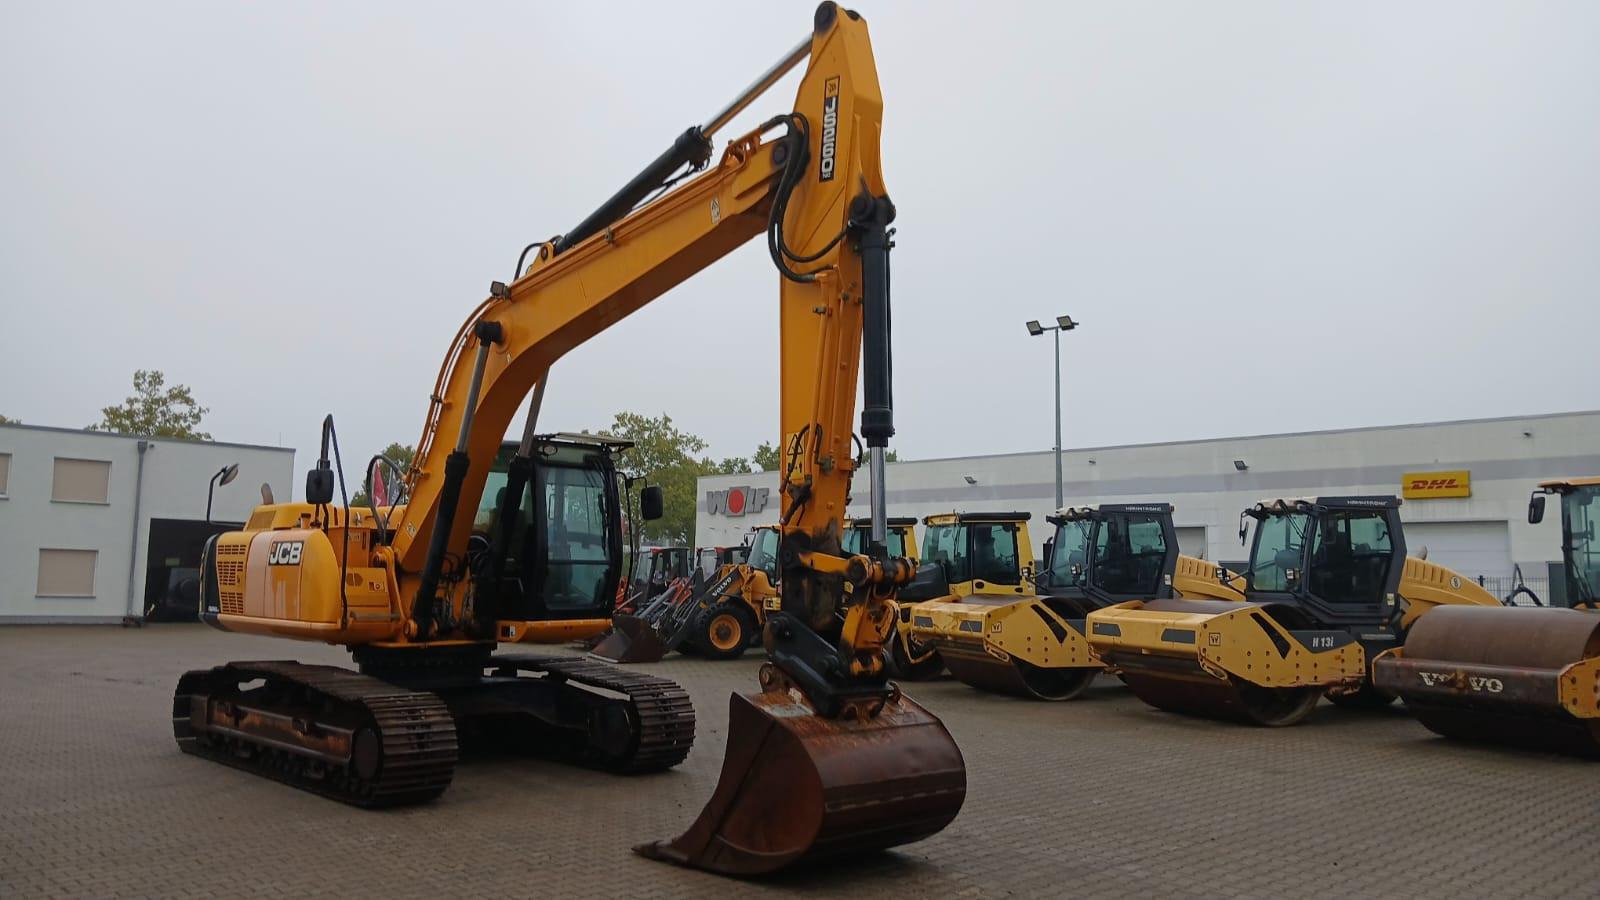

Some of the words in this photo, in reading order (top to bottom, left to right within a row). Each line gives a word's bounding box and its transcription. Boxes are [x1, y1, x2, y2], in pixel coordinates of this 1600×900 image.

[822, 97, 836, 171] JS260
[1411, 478, 1458, 490] DHL
[706, 487, 769, 517] WOLF
[270, 541, 302, 564] JCB
[712, 576, 732, 596] VOLVO
[1312, 637, 1319, 648] H
[1419, 672, 1503, 692] VVO
